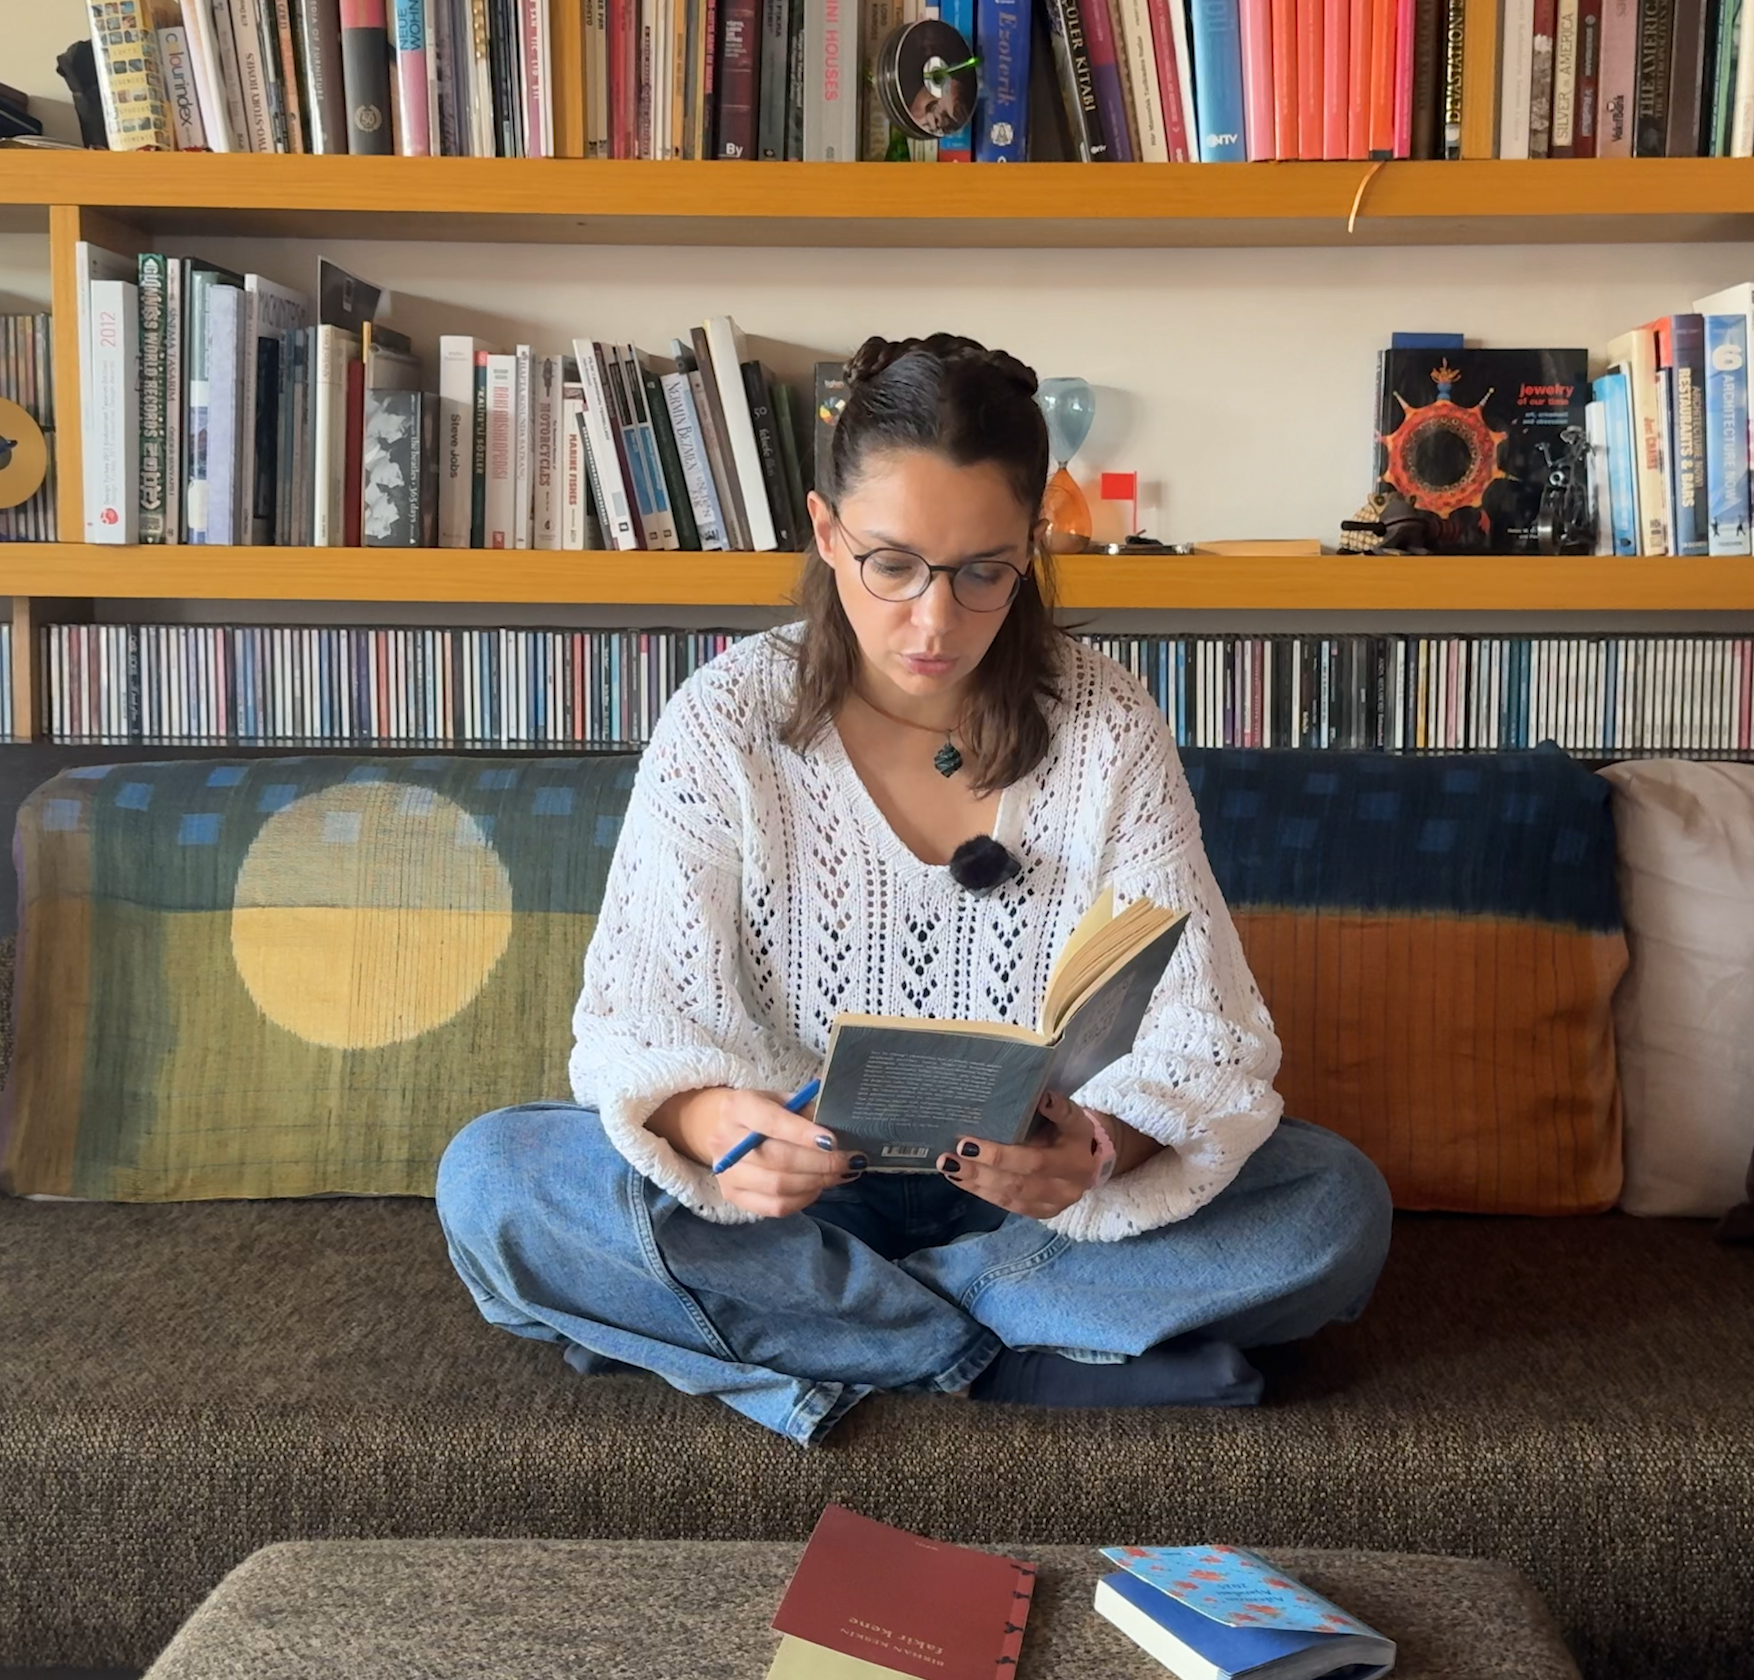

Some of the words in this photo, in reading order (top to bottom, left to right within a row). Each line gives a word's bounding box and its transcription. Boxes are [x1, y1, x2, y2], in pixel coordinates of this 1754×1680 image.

[398, 7, 409, 51] NEUE
[1558, 13, 1575, 76] AMERICA
[244, 53, 258, 91] HOMES
[824, 29, 839, 102] HOUSES
[996, 11, 1018, 106] Ezoterik
[165, 33, 193, 128] colourindex
[1074, 56, 1097, 112] KİTABI
[1640, 78, 1656, 119] THE
[251, 92, 267, 152] TWO-STORY
[1557, 92, 1573, 140] SILVER
[725, 142, 744, 158] By
[1214, 133, 1239, 145] NTV
[142, 264, 161, 329] GUINNESS
[99, 311, 117, 348] 2012
[143, 332, 159, 377] WORLD
[1711, 343, 1743, 372] 6
[518, 361, 527, 392] HAFTA
[1519, 382, 1575, 398] jewelry
[143, 380, 159, 438] RECORDS
[753, 405, 769, 421] 50
[1516, 397, 1527, 406] of
[1528, 397, 1545, 406] our
[1678, 367, 1693, 457] RESTAURANTS
[449, 414, 462, 447] Steve
[1692, 385, 1703, 460] ARCHITECTURE
[1722, 374, 1737, 469] ARCHITECTURE
[409, 436, 418, 450] the
[539, 402, 551, 487] MOTORCYCLES
[568, 433, 578, 472] MARINE
[676, 426, 699, 471] BEZMEN
[141, 442, 162, 502] 2002
[409, 450, 418, 481] beatles
[448, 449, 462, 479] Jobs
[1681, 458, 1693, 470] &
[407, 485, 417, 503] 365
[568, 473, 578, 506] FISHES
[1681, 472, 1694, 508] BARS
[1723, 469, 1737, 505] NOW!
[408, 503, 418, 524] days
[847, 1616, 893, 1639] kene
[897, 1634, 944, 1656] fakir
